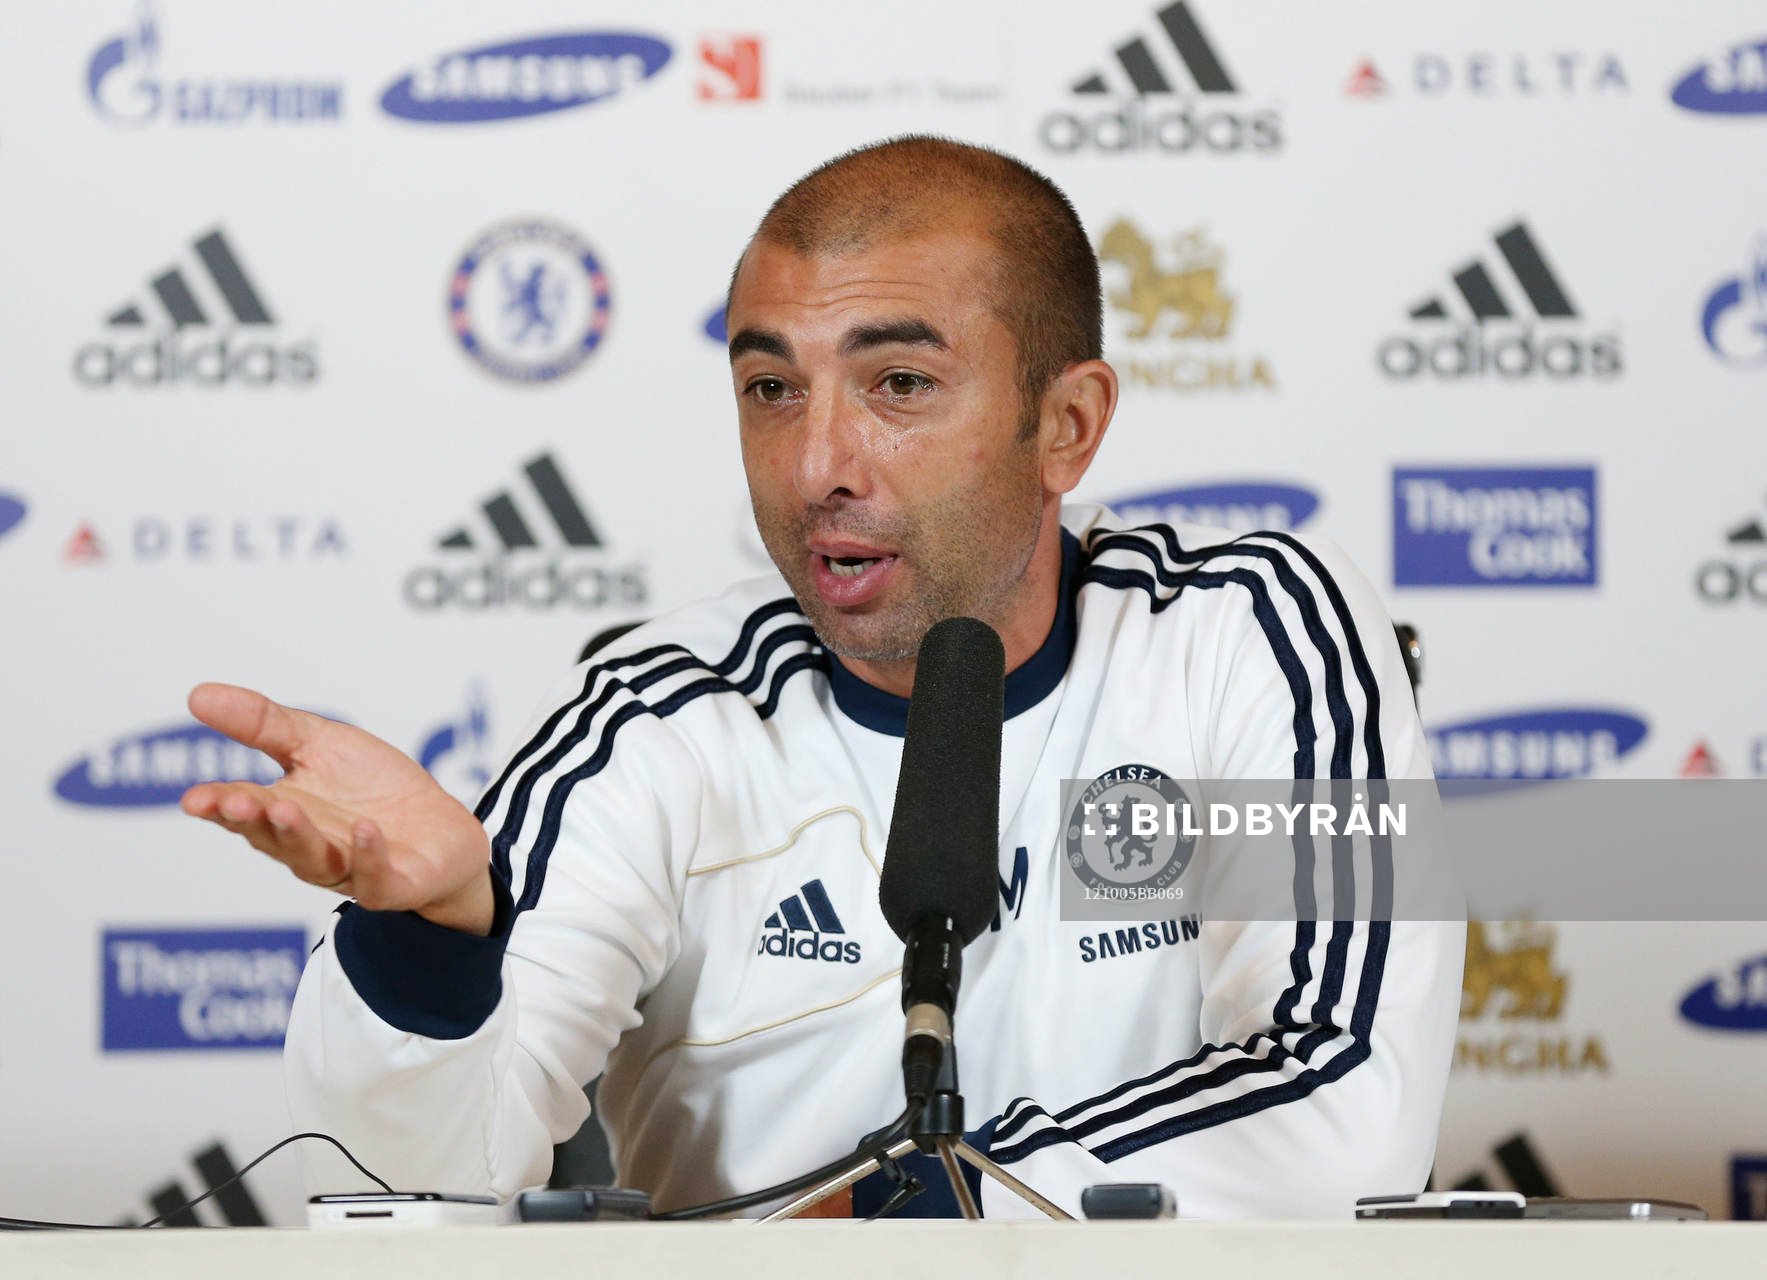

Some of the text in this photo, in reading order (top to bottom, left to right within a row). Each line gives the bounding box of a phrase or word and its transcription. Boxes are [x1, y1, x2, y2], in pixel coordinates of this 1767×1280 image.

[410, 52, 648, 103] SAMSUNG
[1414, 54, 1628, 94] DELTA
[1040, 95, 1281, 153] adidas
[73, 327, 316, 385] adidas
[1379, 322, 1622, 380] adidas
[1402, 478, 1589, 534] Thomas
[133, 517, 346, 560] DELTA
[1468, 528, 1589, 578] Cook
[404, 548, 648, 608] adidas
[1081, 767, 1162, 805] CHELSEA
[1157, 860, 1182, 886] CLUB
[1079, 912, 1203, 963] SAMSUN
[112, 940, 301, 996] Thomas
